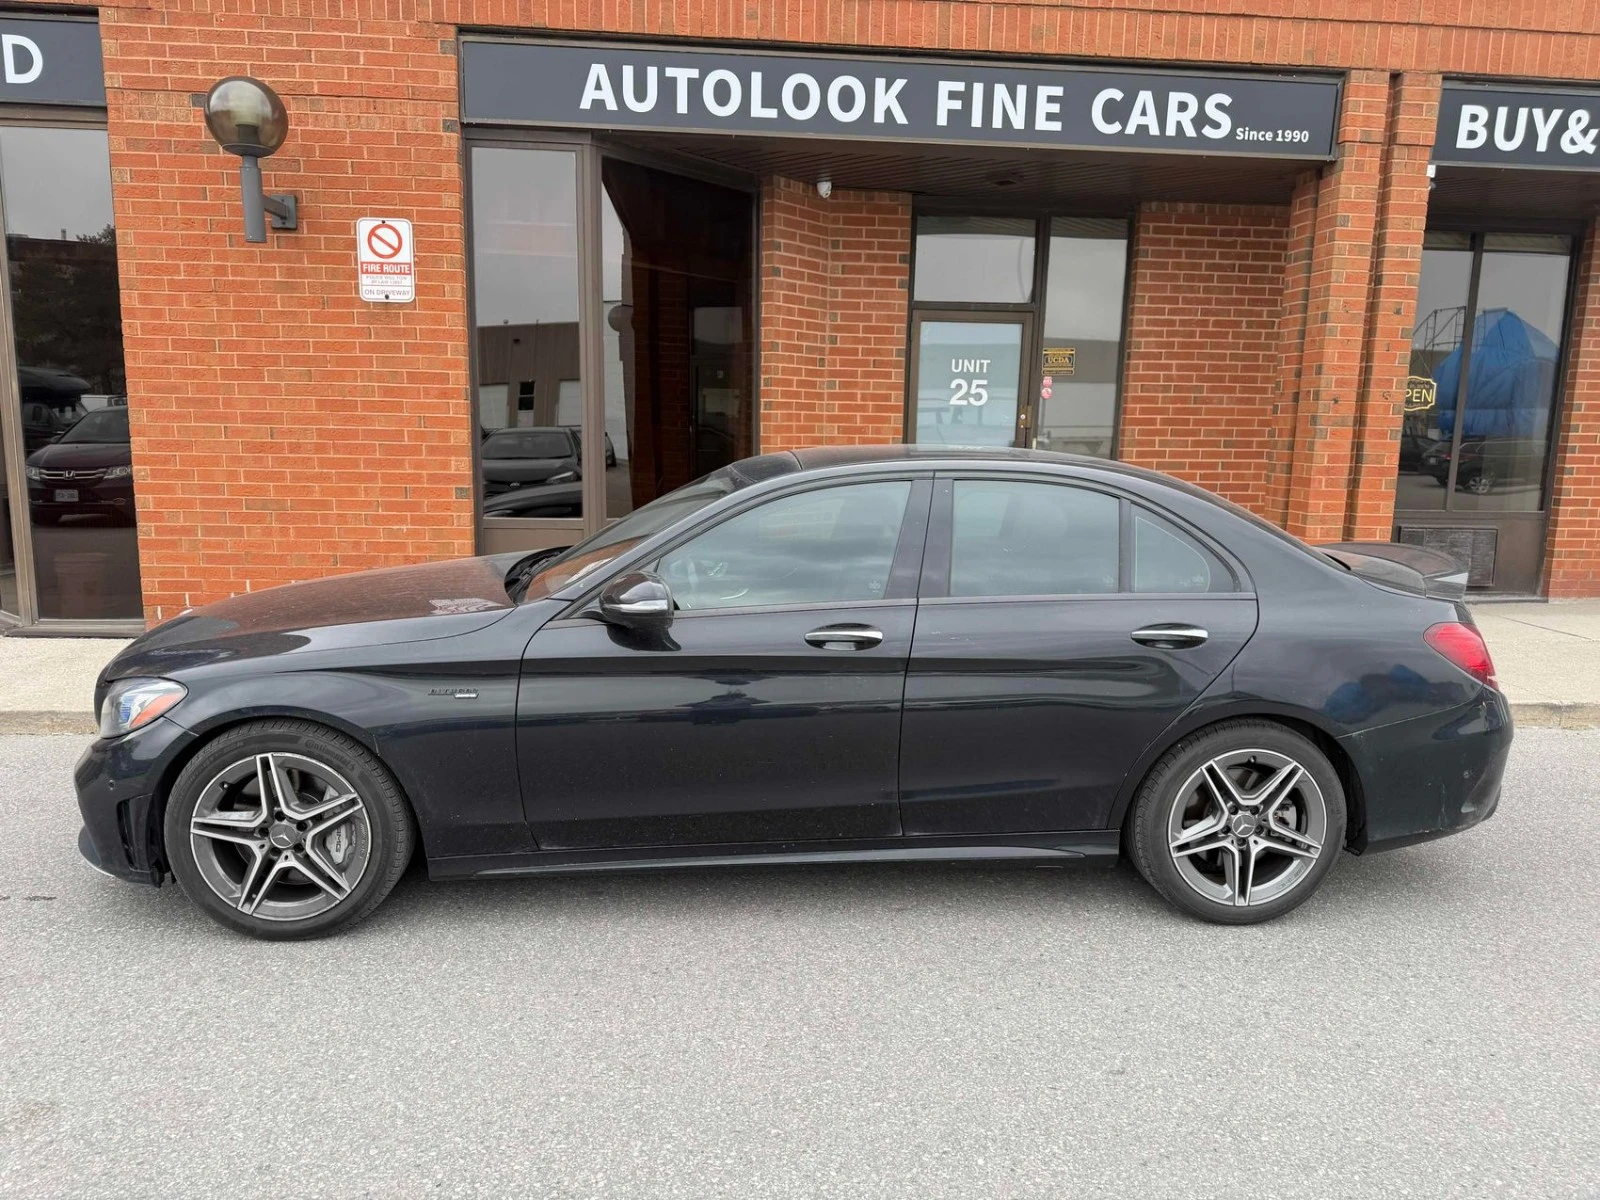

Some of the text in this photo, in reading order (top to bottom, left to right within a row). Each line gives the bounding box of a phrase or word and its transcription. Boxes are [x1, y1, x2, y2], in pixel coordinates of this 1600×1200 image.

[1, 33, 43, 84] D
[579, 62, 1309, 143] AUTOLOOK FINE CARS Since 1990
[1455, 104, 1600, 155] BUY&
[362, 263, 410, 274] FIRE ROUTE
[951, 358, 991, 373] UNIT
[949, 378, 988, 406] 25
